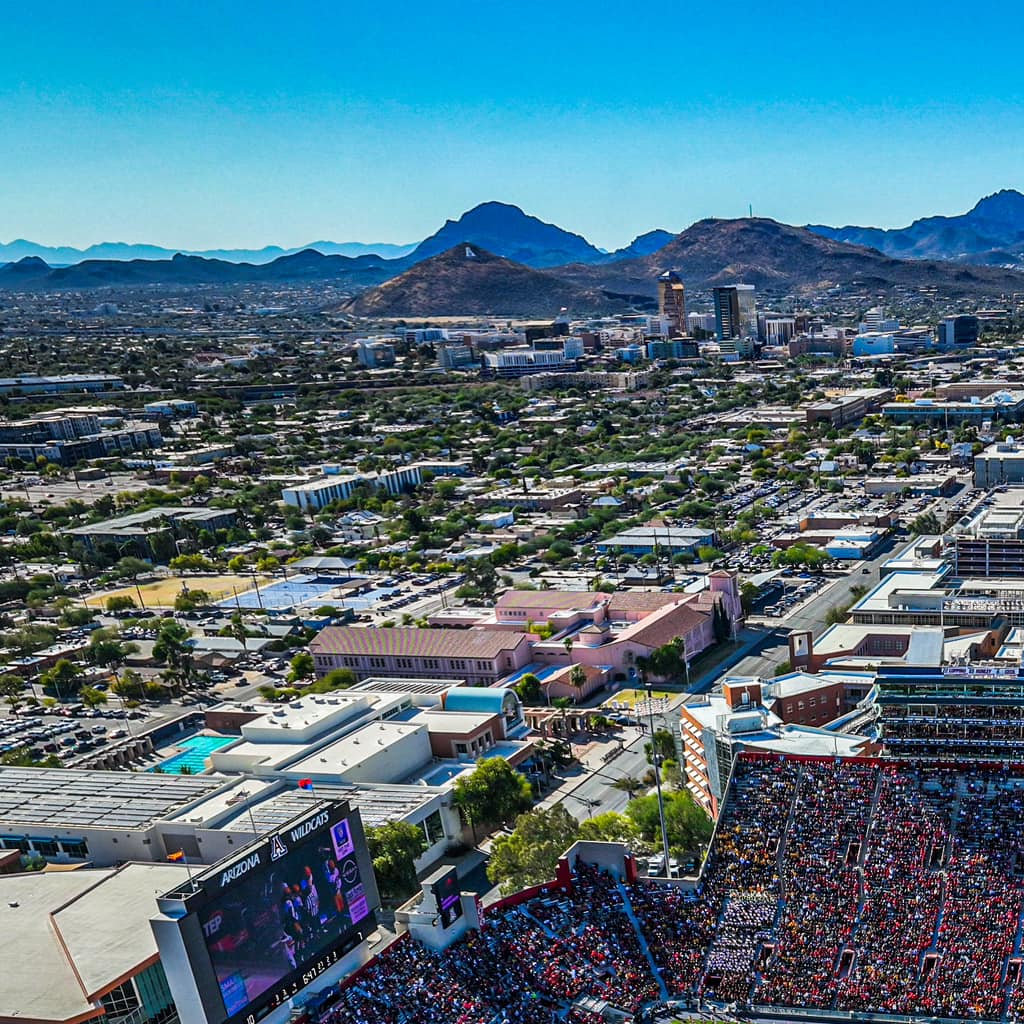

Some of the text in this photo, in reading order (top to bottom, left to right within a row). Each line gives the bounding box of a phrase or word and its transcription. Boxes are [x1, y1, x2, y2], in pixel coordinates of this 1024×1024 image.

[290, 811, 330, 843] WILDCATS
[271, 834, 288, 861] A
[220, 853, 261, 887] ARIZONA
[203, 915, 222, 937] TEP
